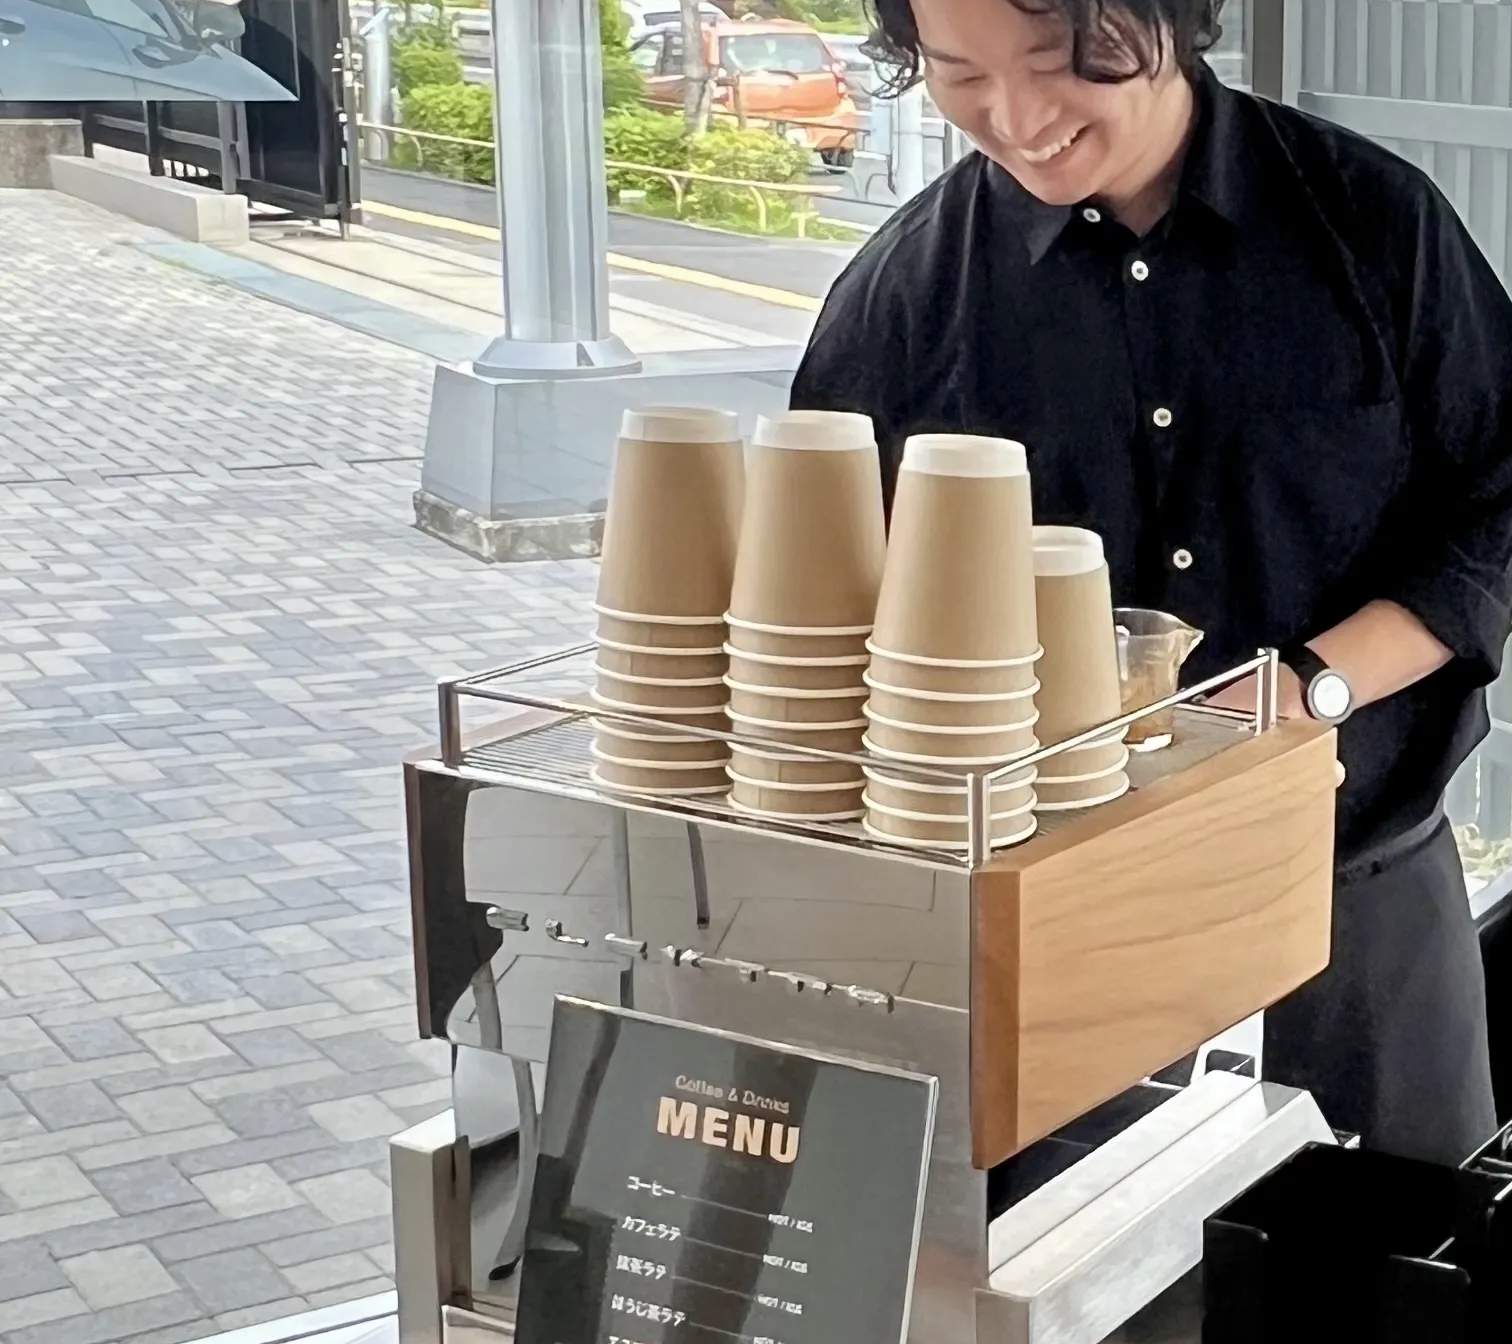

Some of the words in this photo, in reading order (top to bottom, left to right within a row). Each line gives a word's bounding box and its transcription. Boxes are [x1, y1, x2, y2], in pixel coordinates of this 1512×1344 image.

[656, 1095, 801, 1164] MENU
[627, 1175, 676, 1197] コーヒー
[621, 1215, 681, 1242] カフェラテ
